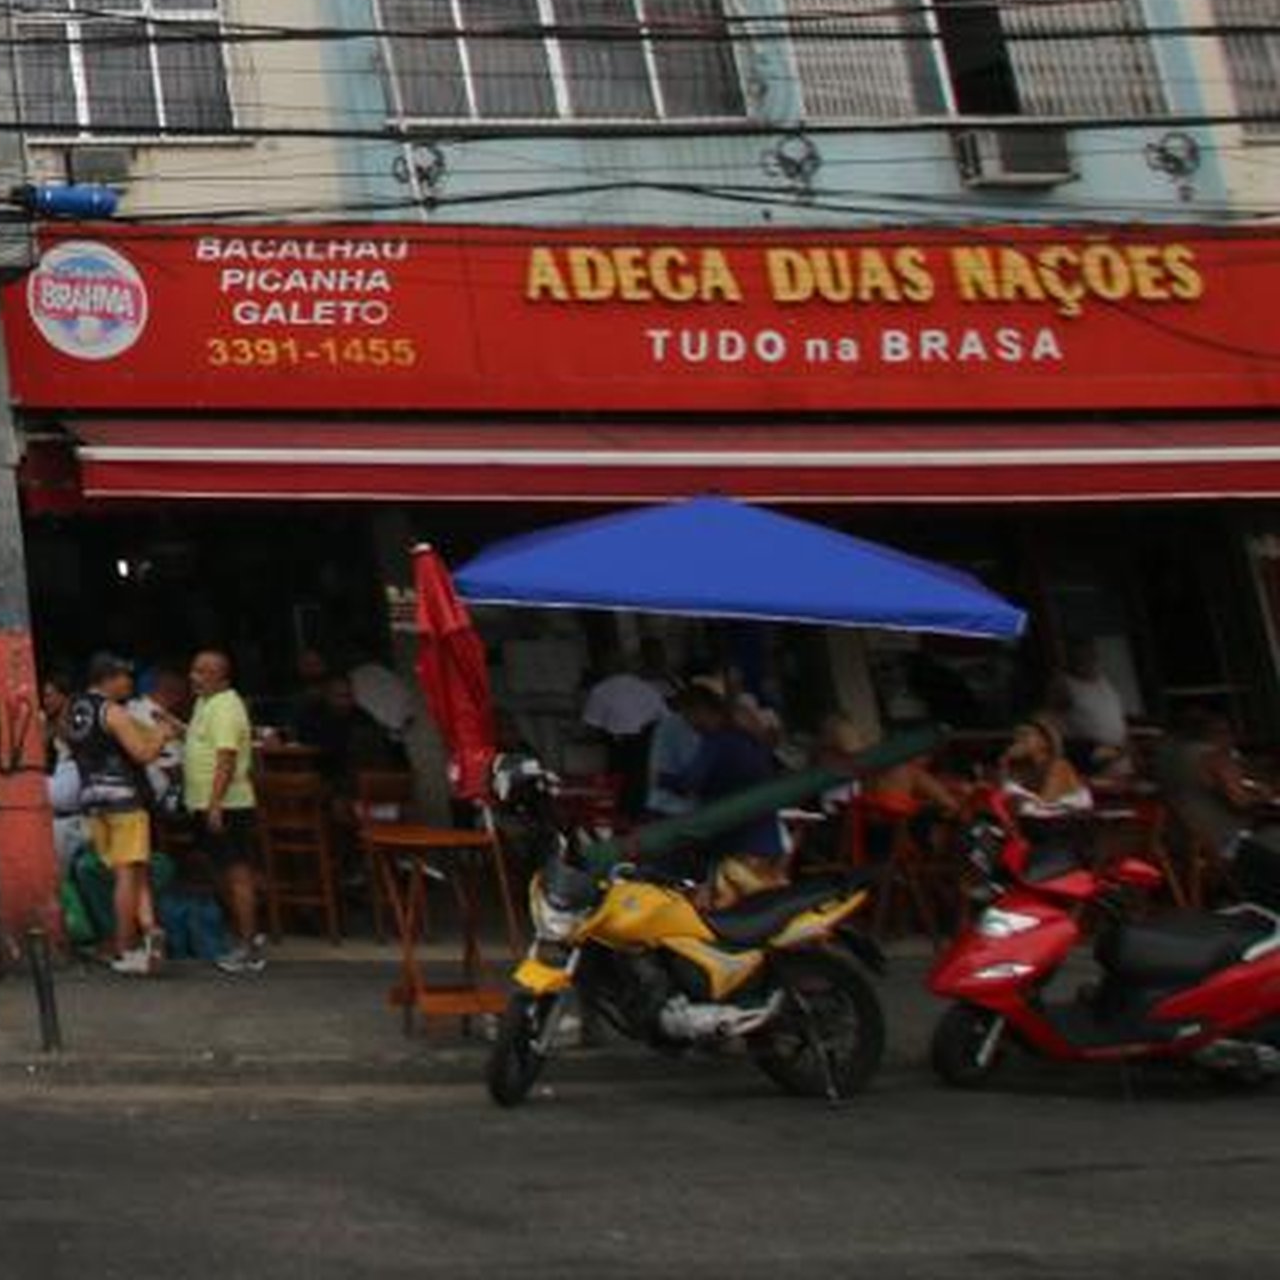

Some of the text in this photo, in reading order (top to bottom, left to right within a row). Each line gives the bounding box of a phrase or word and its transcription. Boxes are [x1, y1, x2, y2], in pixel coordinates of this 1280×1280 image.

[196, 236, 408, 261] BACALHAU
[220, 267, 391, 293] PICANHA
[528, 233, 1204, 317] ADEGA DUAS NAÇÕES
[40, 279, 134, 317] BRAHMA
[232, 300, 389, 325] GALETO
[207, 338, 416, 368] 3391-1455
[648, 328, 1062, 362] TUDO na BRASA
